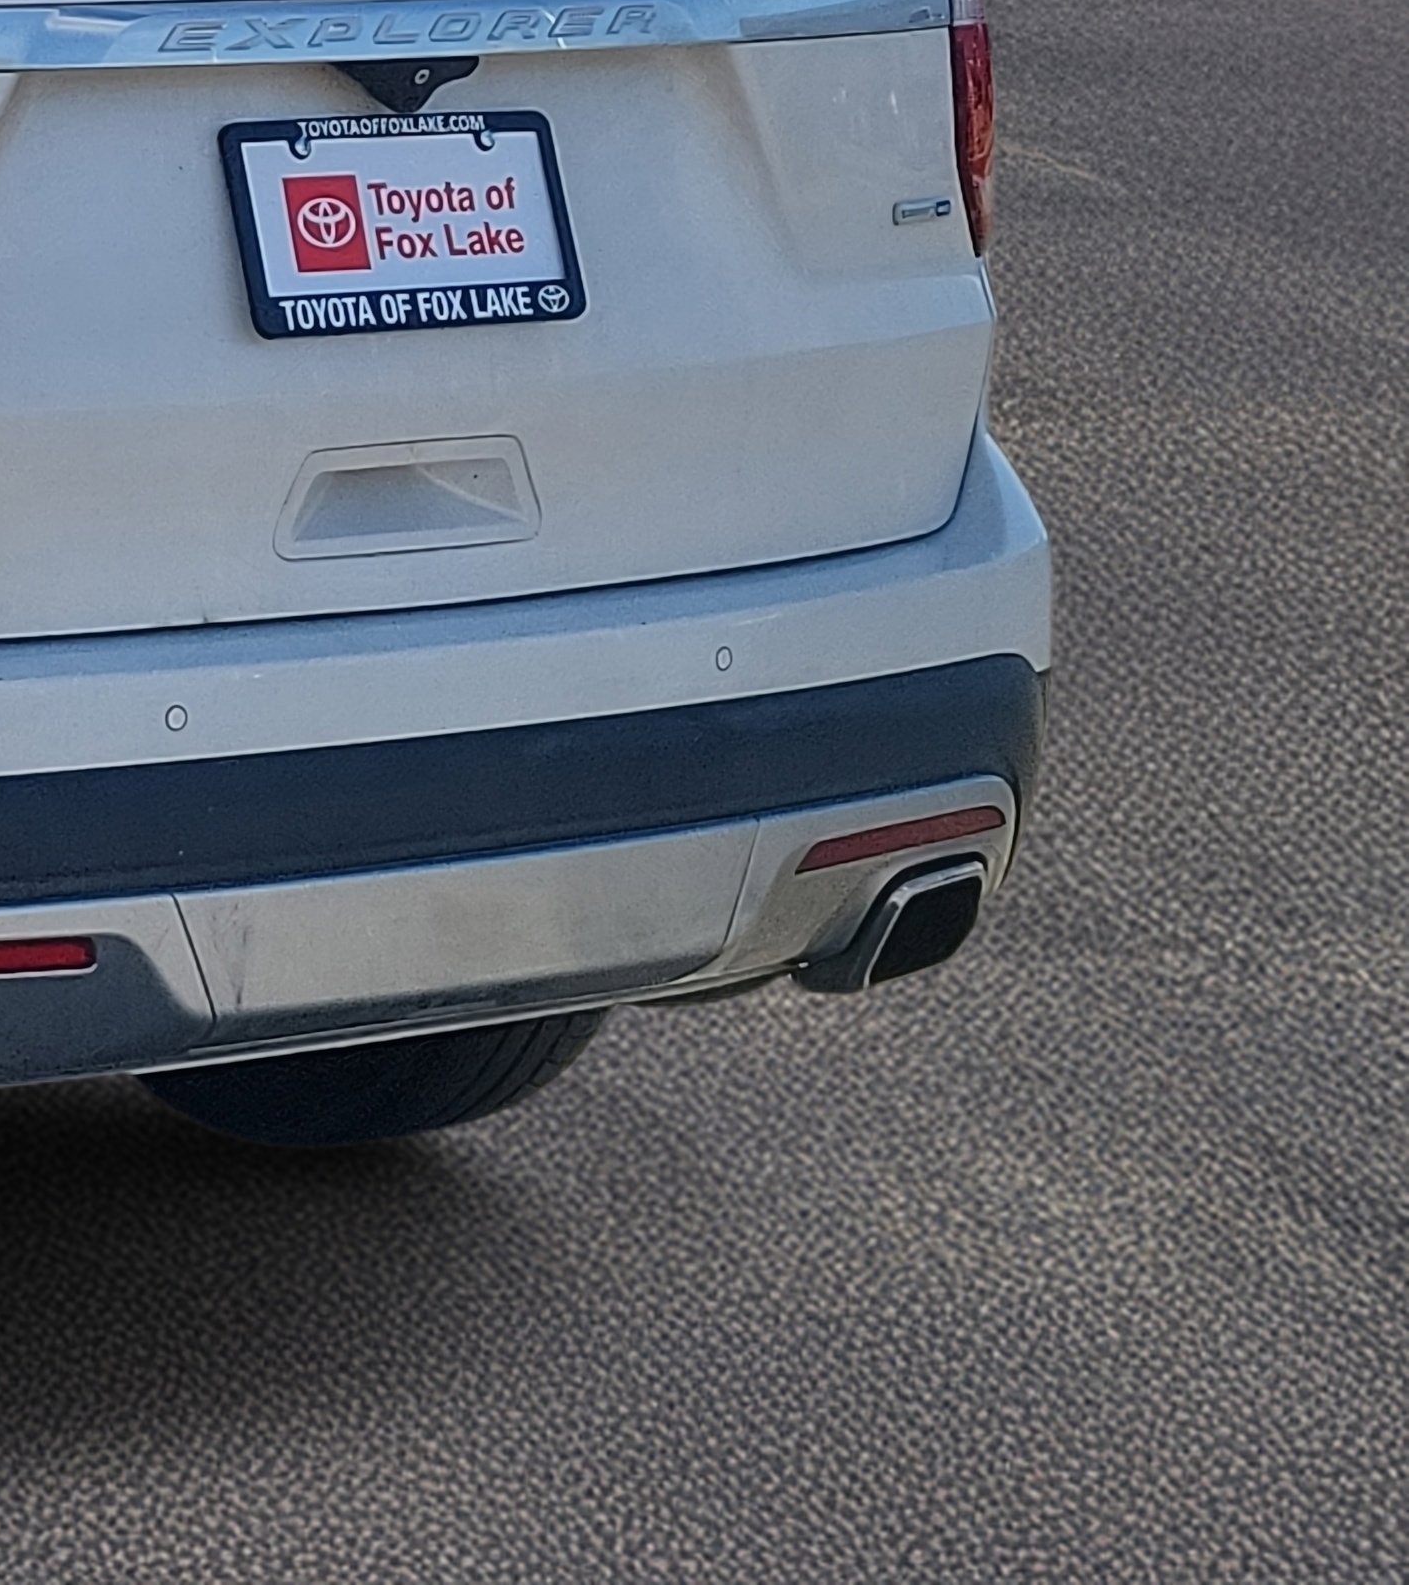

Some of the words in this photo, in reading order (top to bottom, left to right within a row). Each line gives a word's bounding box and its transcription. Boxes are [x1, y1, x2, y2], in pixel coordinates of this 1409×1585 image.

[157, 2, 658, 54] EXPLORER
[297, 114, 485, 139] TOYOTAOFFOXLAKE.COM
[367, 180, 475, 223] Toyota
[486, 176, 516, 210] of
[375, 226, 438, 261] Fox
[443, 221, 525, 257] Lake
[279, 295, 377, 332] TOYOTA
[380, 293, 413, 325] OF
[418, 290, 469, 324] FOX
[469, 285, 534, 320] LAKE
